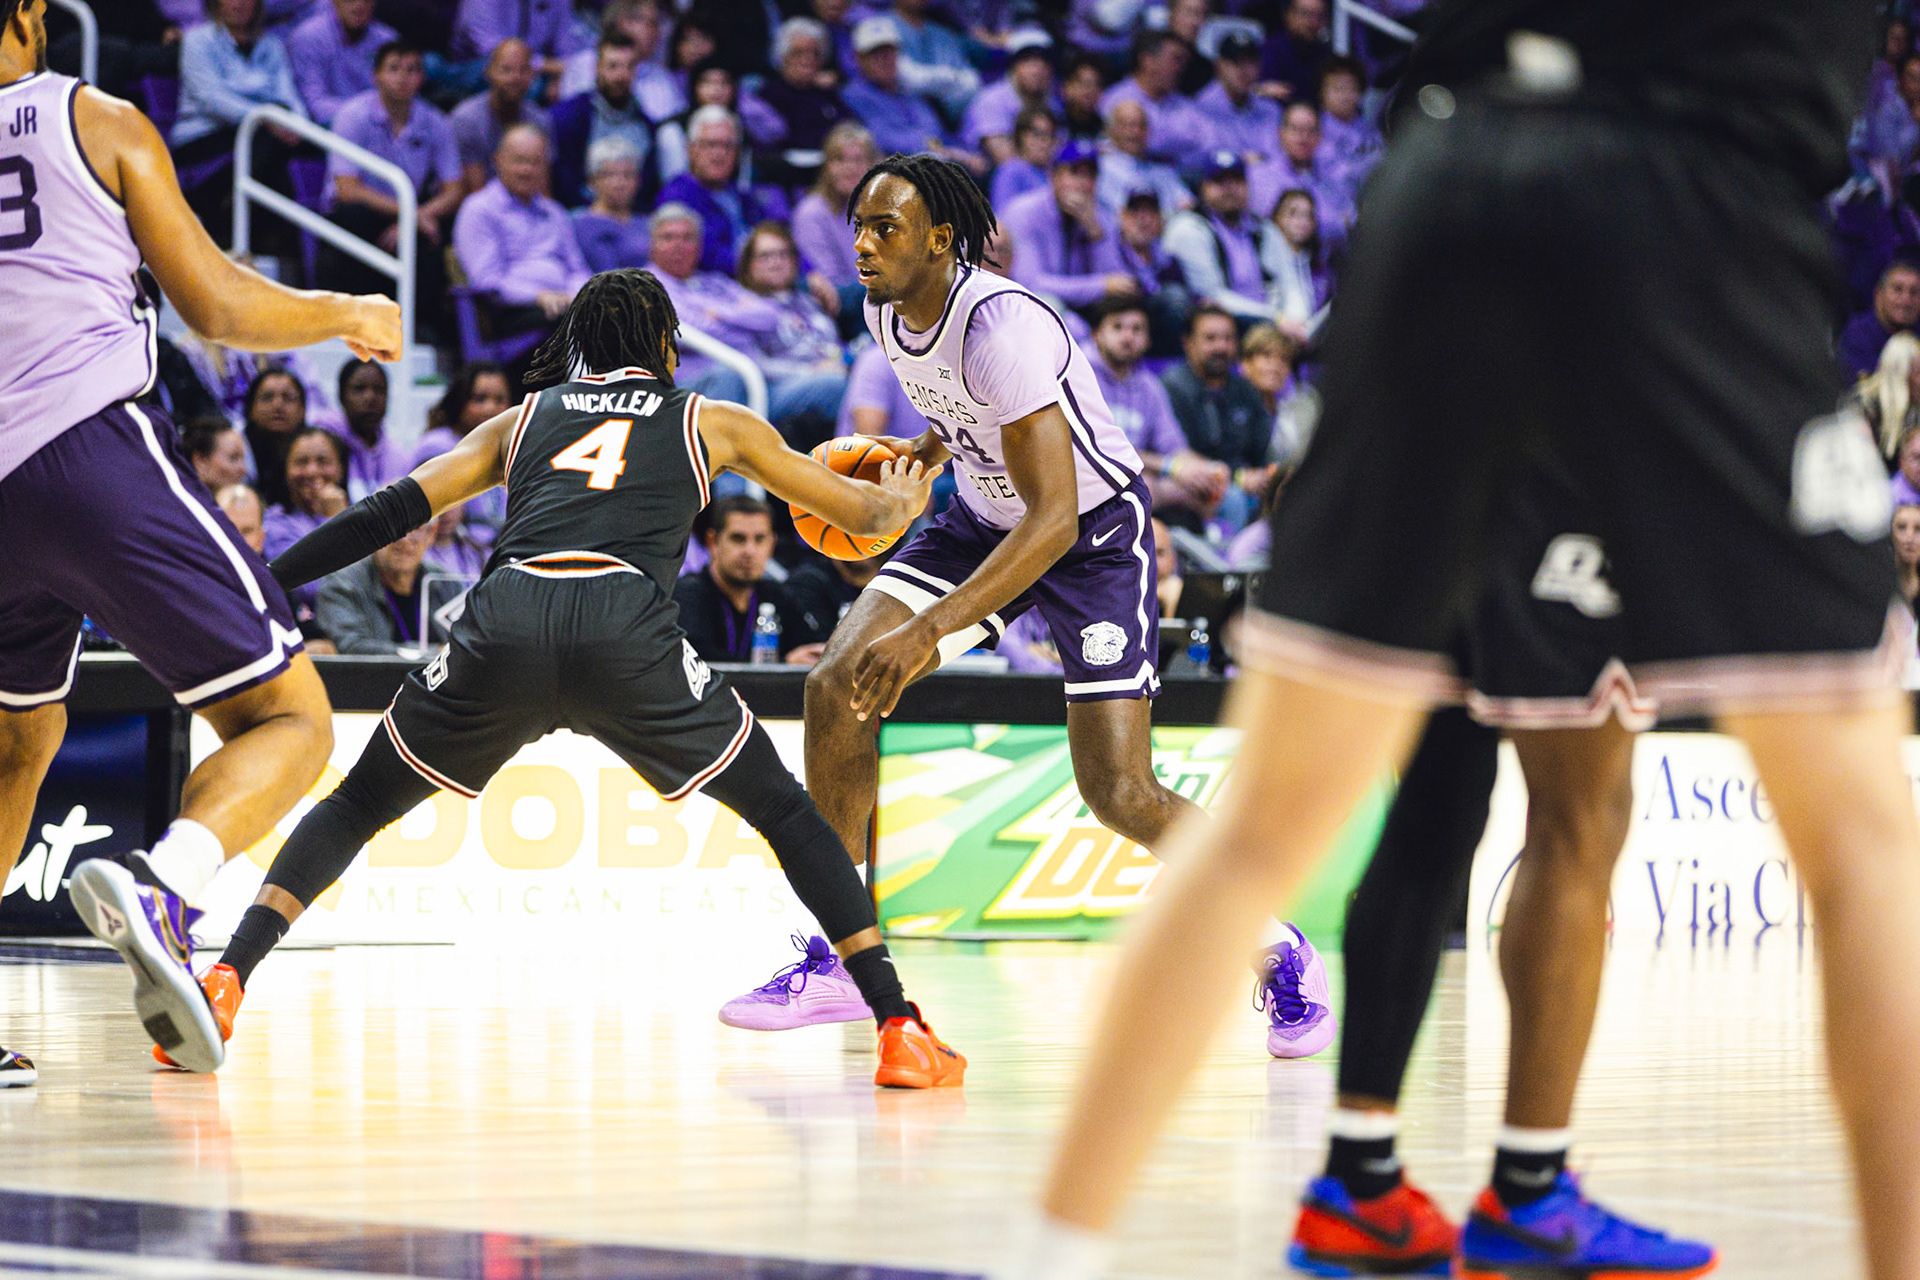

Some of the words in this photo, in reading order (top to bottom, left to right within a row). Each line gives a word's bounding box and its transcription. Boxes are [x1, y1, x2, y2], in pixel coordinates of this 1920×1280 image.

[9, 106, 37, 137] JR
[0, 154, 43, 250] 3
[561, 389, 664, 417] HICKLEN
[899, 379, 979, 425] ANSAS
[550, 418, 634, 491] 4
[925, 414, 996, 464] 24
[367, 886, 622, 914] MEXICAN
[660, 886, 787, 914] EATS
[1644, 858, 1733, 927] Via
